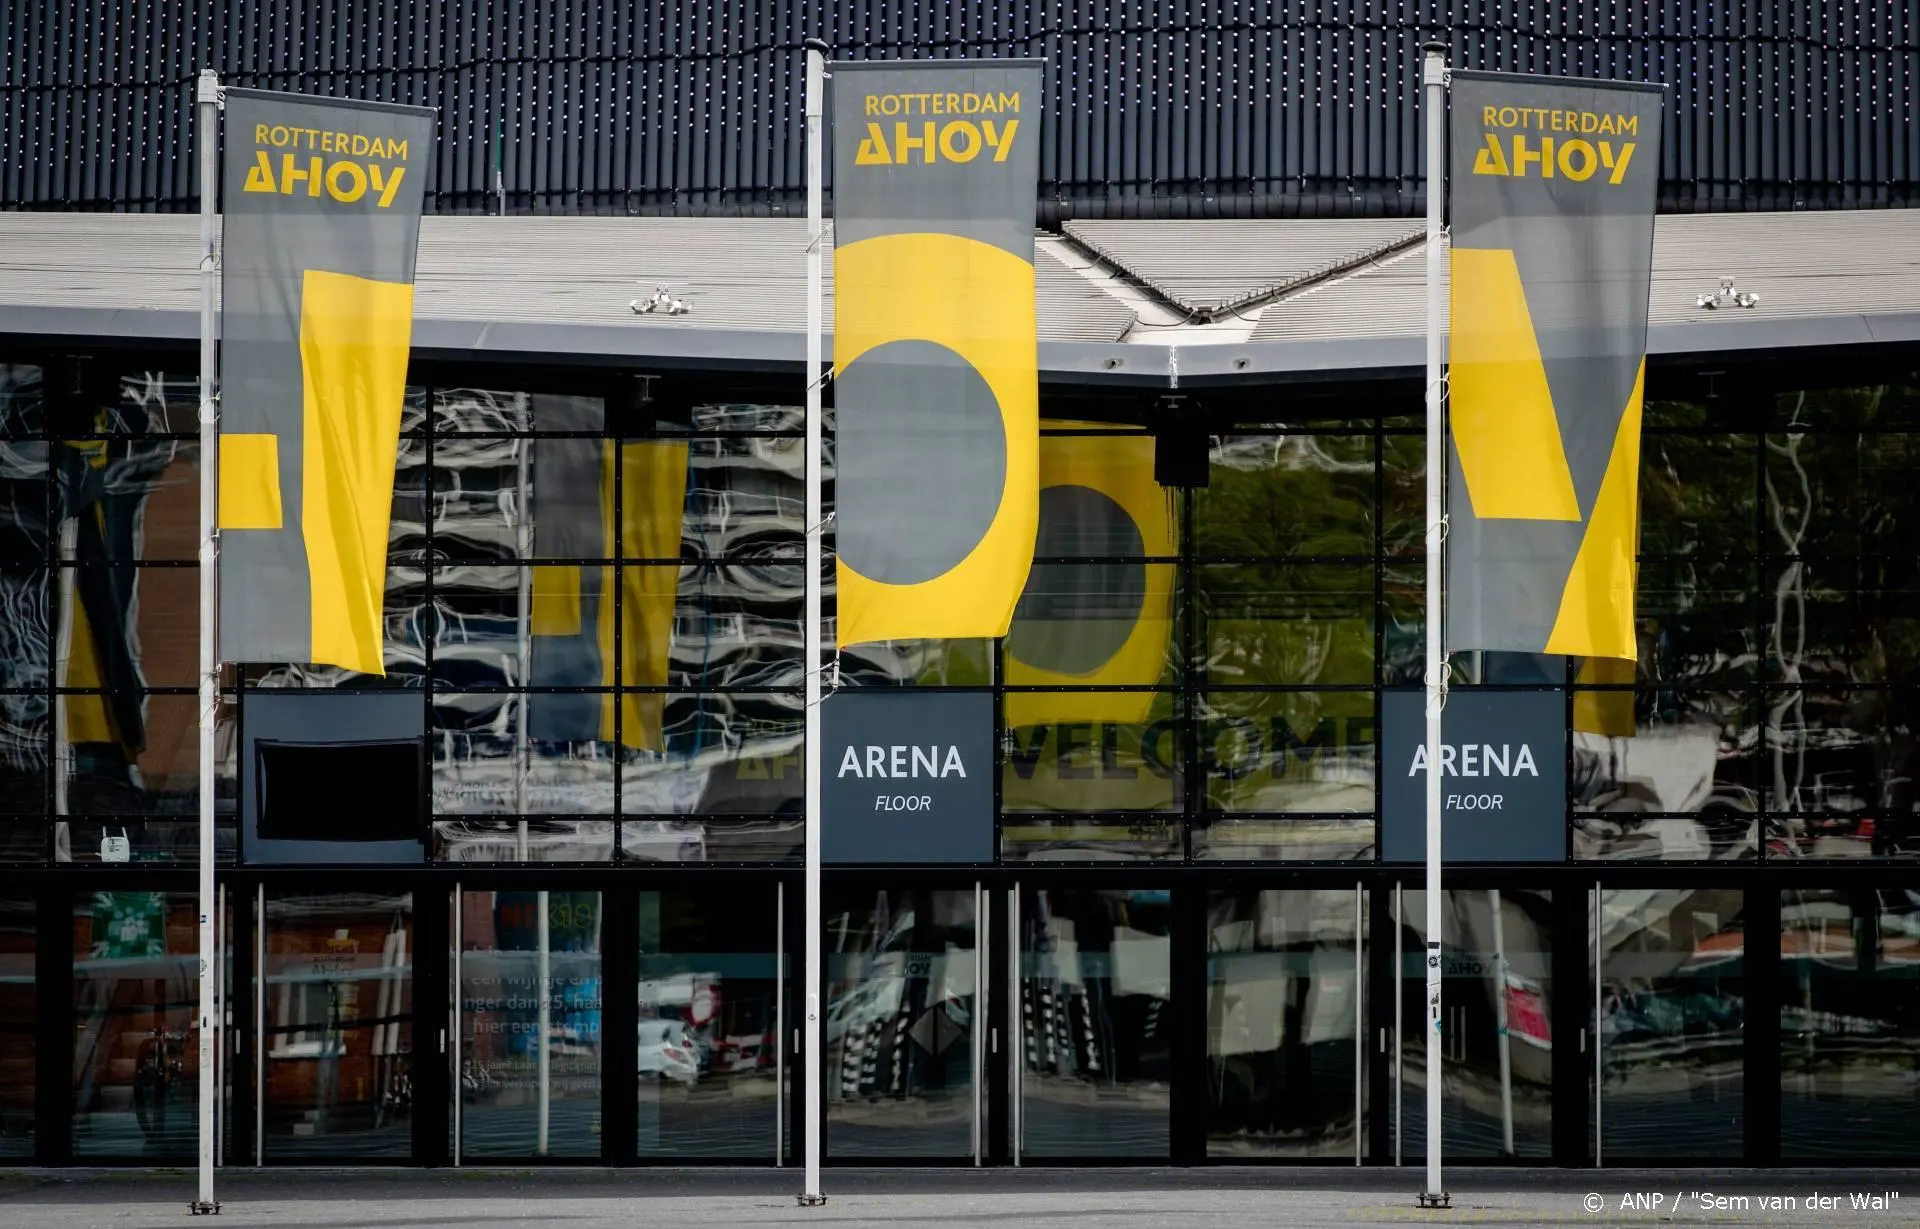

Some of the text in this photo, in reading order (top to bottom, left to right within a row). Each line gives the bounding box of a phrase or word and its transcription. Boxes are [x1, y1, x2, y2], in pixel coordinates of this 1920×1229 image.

[864, 93, 1020, 116] ROTTERDAM
[1484, 106, 1639, 136] ROTTERDAM
[256, 125, 409, 161] ROTTERDAM
[855, 119, 1019, 166] AHOY
[1473, 134, 1637, 186] AHOY
[243, 151, 406, 208] AHOY
[838, 745, 967, 778] ARENA
[1409, 744, 1540, 778] ARENA
[875, 795, 932, 811] FLOOR
[1446, 794, 1504, 810] FLOOR
